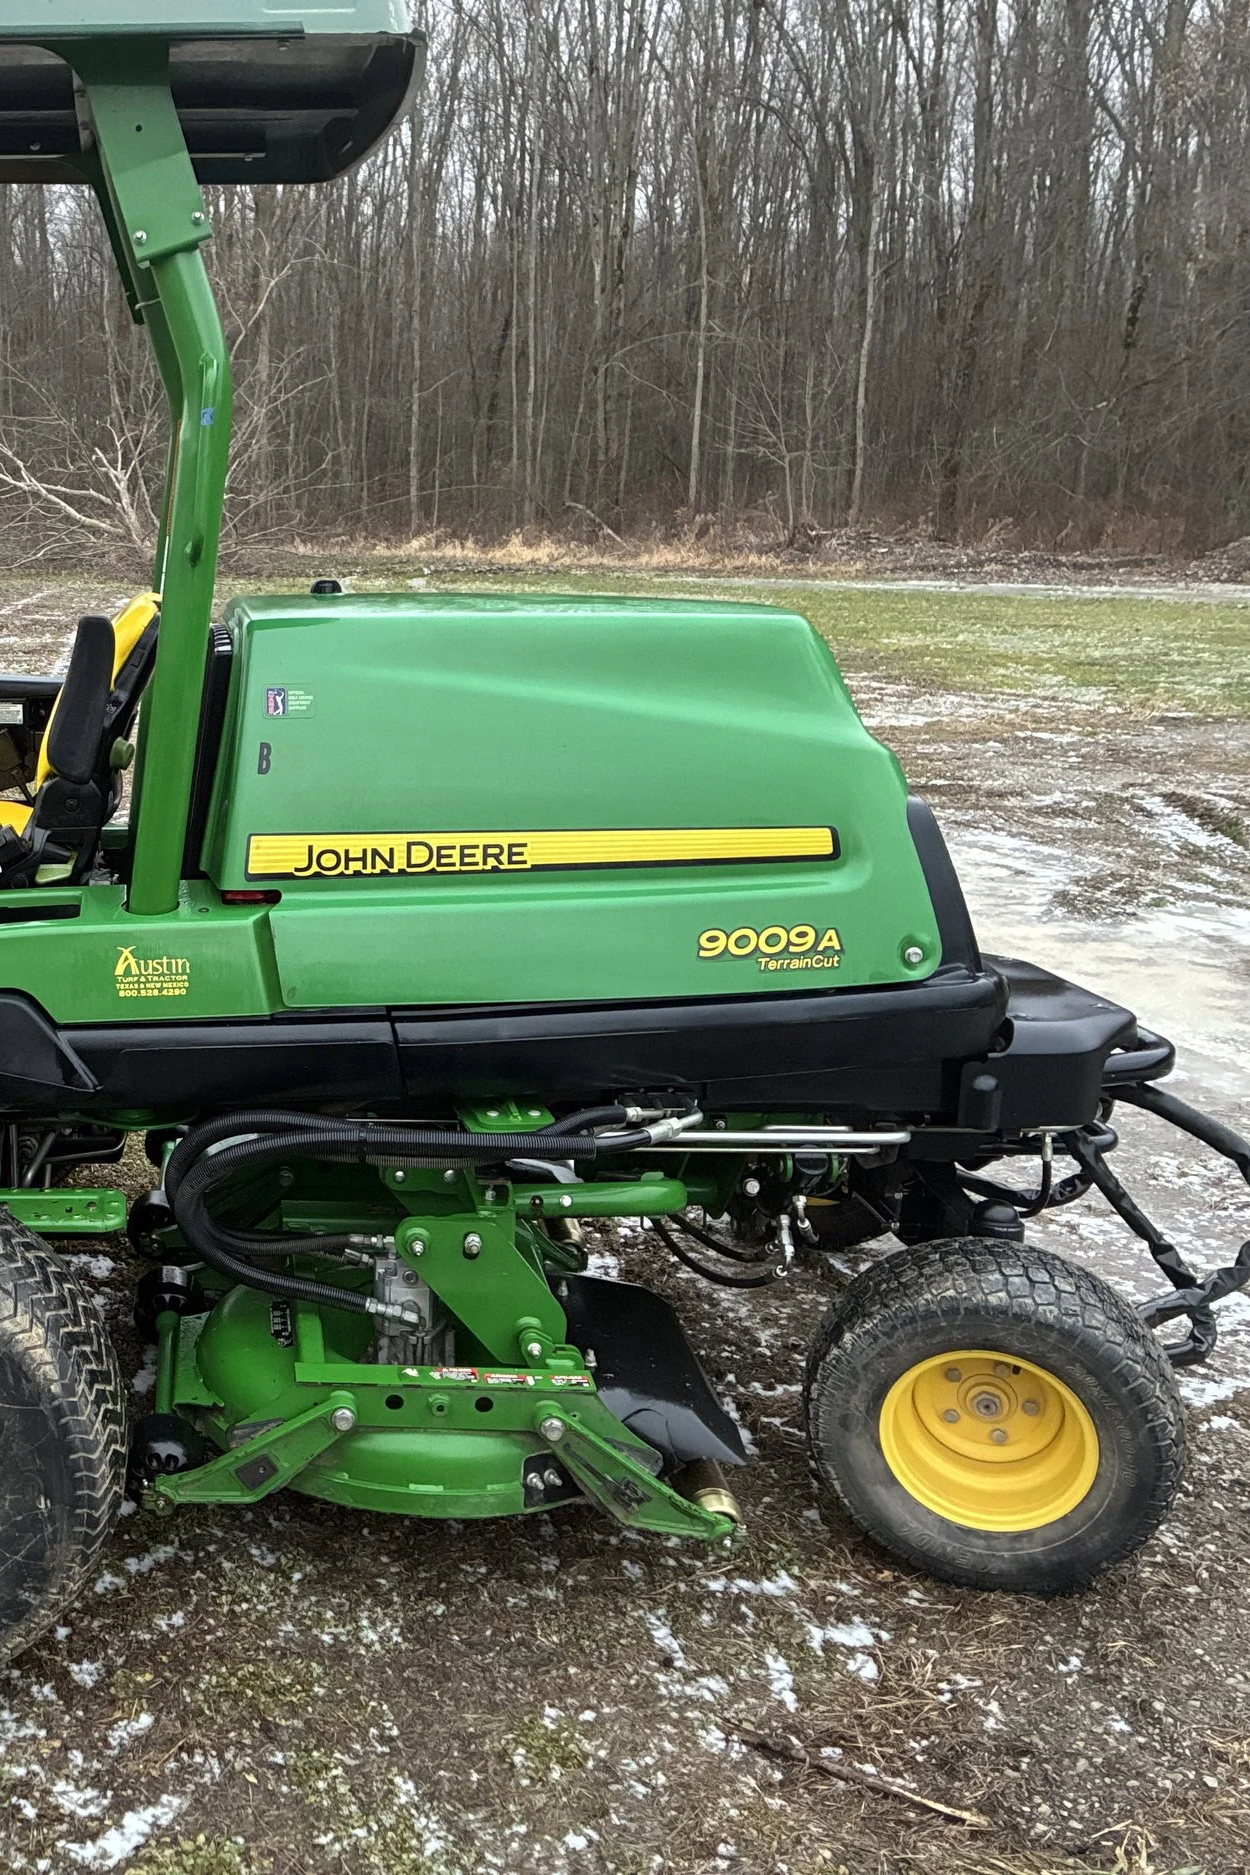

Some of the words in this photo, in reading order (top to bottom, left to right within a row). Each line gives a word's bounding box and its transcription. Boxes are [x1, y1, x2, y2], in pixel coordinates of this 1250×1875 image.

[257, 741, 272, 775] B
[293, 843, 396, 873] JOHN
[405, 841, 529, 868] DEERE
[698, 924, 842, 958] 9009A
[114, 945, 191, 976] Austin
[757, 955, 841, 971] TerrainCut
